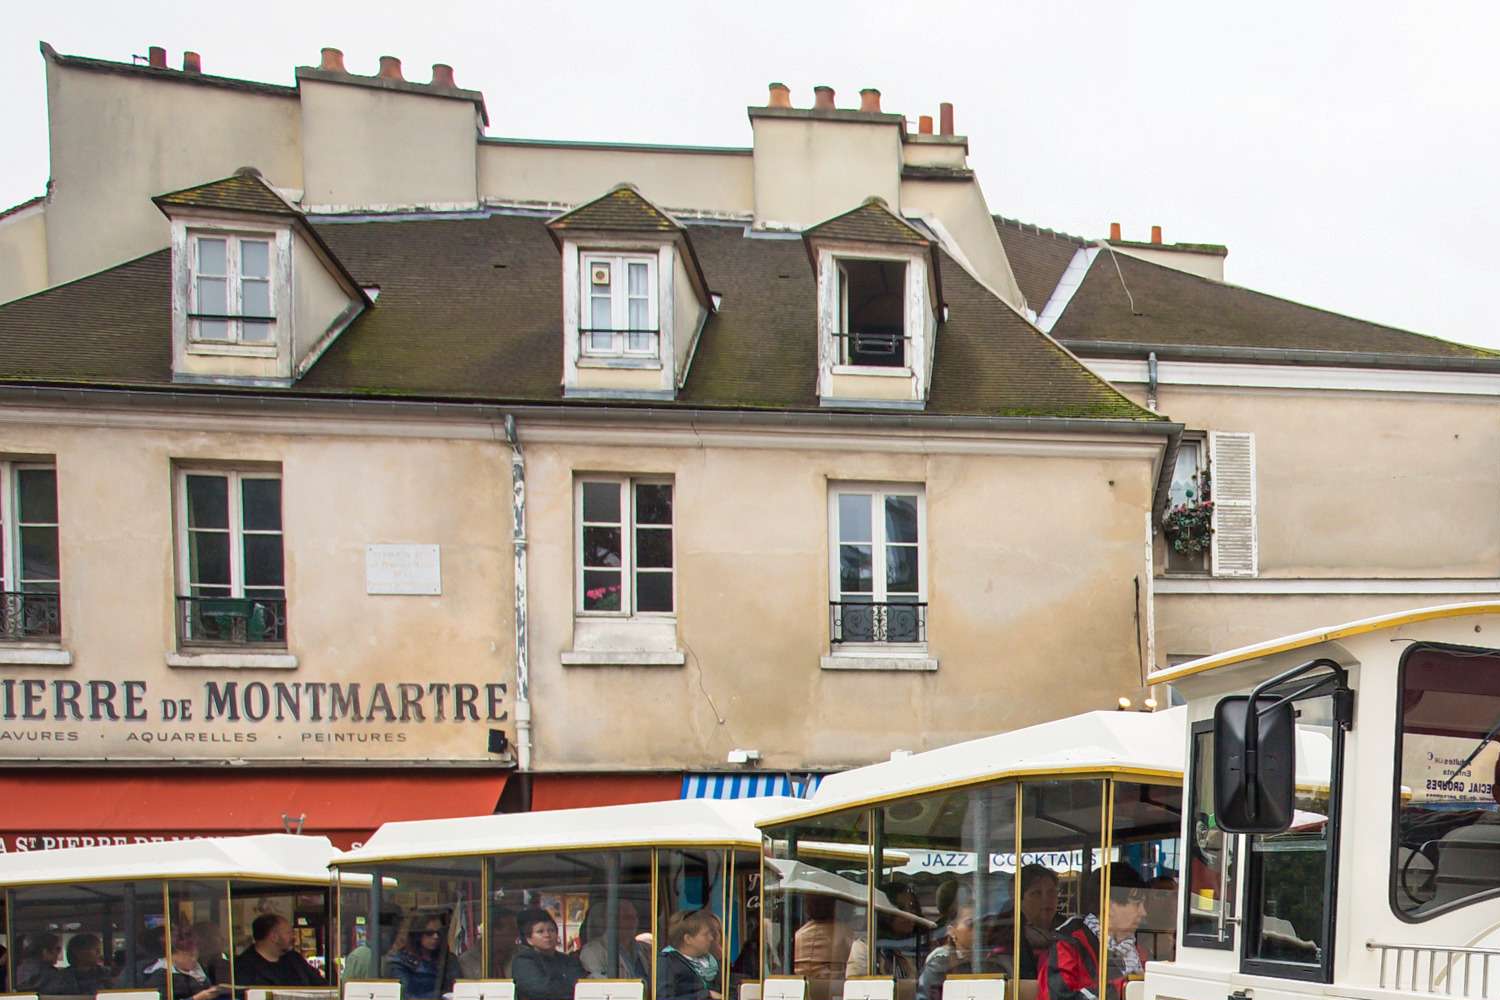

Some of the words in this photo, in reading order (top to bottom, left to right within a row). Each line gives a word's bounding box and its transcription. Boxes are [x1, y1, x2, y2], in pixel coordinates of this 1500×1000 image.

[161, 698, 193, 721] DE
[204, 681, 509, 722] MONTMARTRE
[0, 731, 80, 742] AVURES
[126, 732, 258, 743] AQUARELLES
[301, 732, 408, 743] PEINTURES
[922, 853, 970, 868] JAZZ
[992, 852, 1097, 868] COCKTAILS
